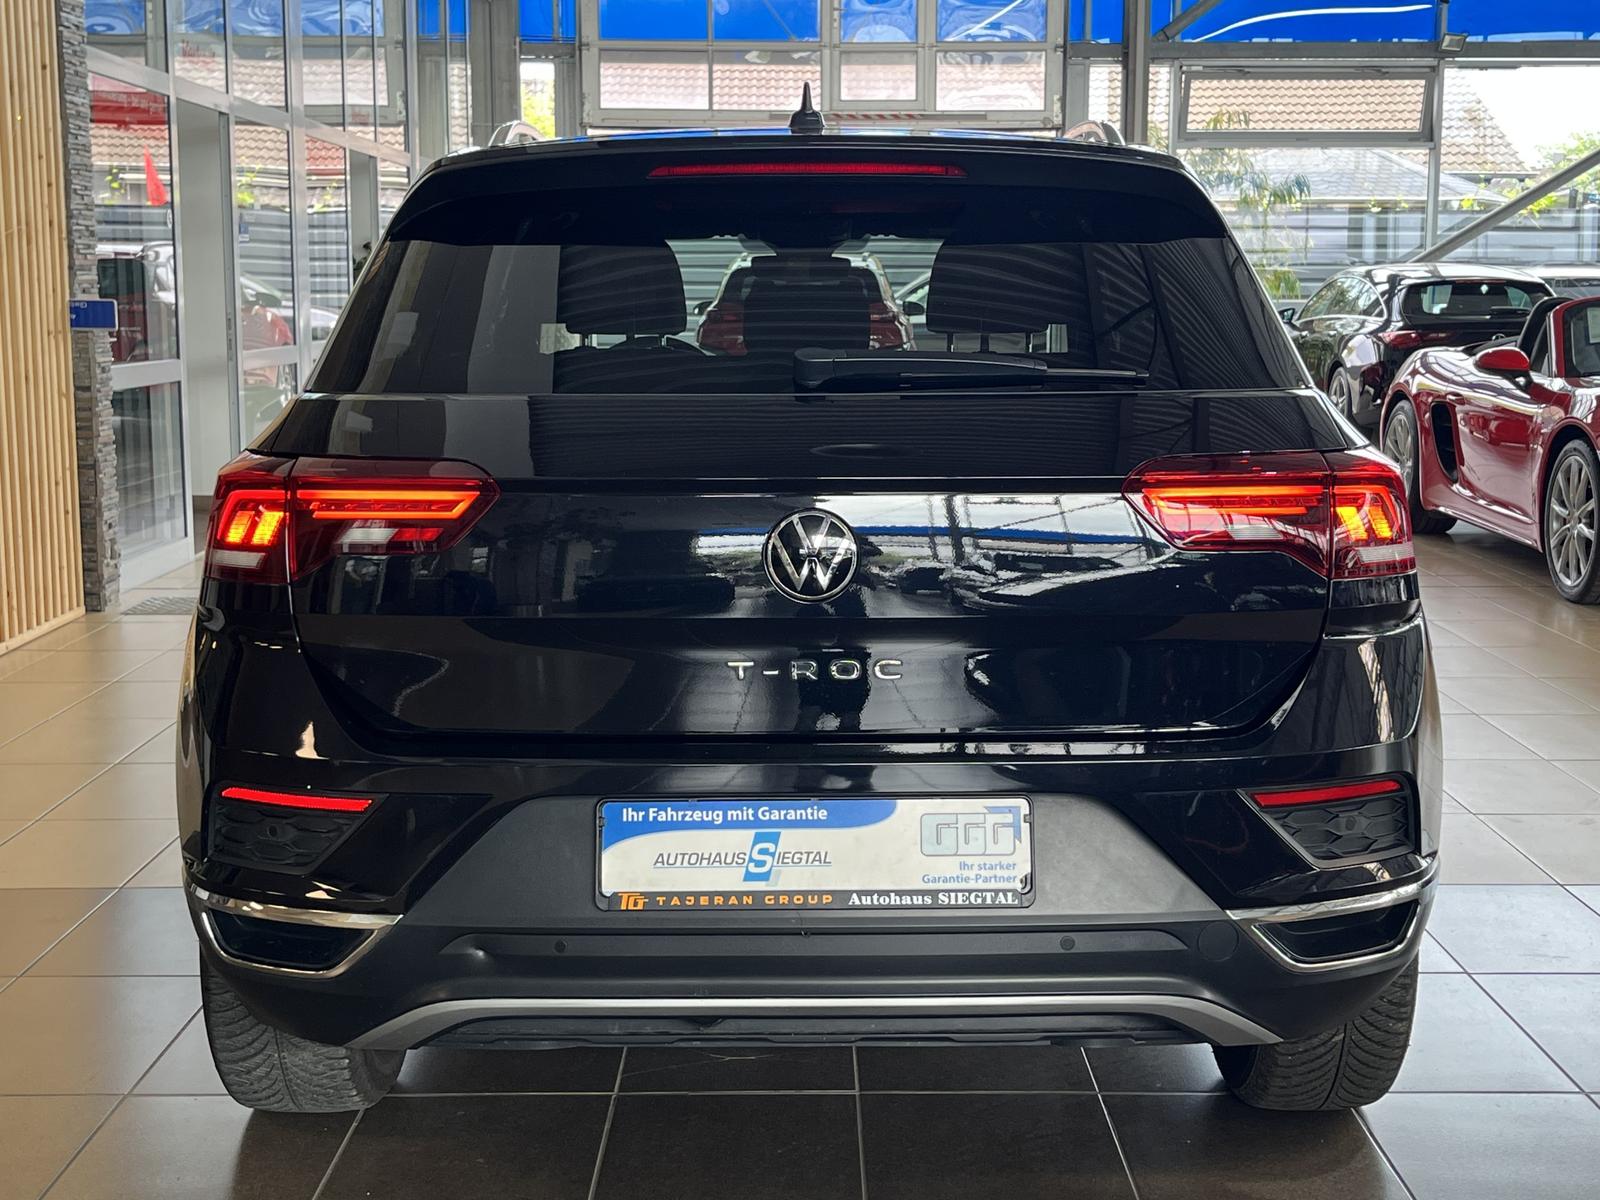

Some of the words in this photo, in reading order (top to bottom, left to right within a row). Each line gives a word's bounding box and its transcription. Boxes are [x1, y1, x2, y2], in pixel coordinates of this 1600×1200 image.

[727, 660, 903, 680] T-ROC
[622, 807, 645, 822] Ihr
[648, 807, 723, 825] Fahrzeug
[727, 806, 754, 822] mit
[757, 806, 828, 821] Garantie
[653, 852, 747, 867] AUTOHAUS
[959, 860, 974, 871] Ihr
[977, 860, 1017, 871] starker
[921, 873, 1017, 885] Garantie-Partner
[656, 895, 753, 906] TAJERAN
[764, 894, 833, 905] GROUP
[848, 892, 933, 906] Autohaus
[938, 891, 1019, 906] SIEGTAL
